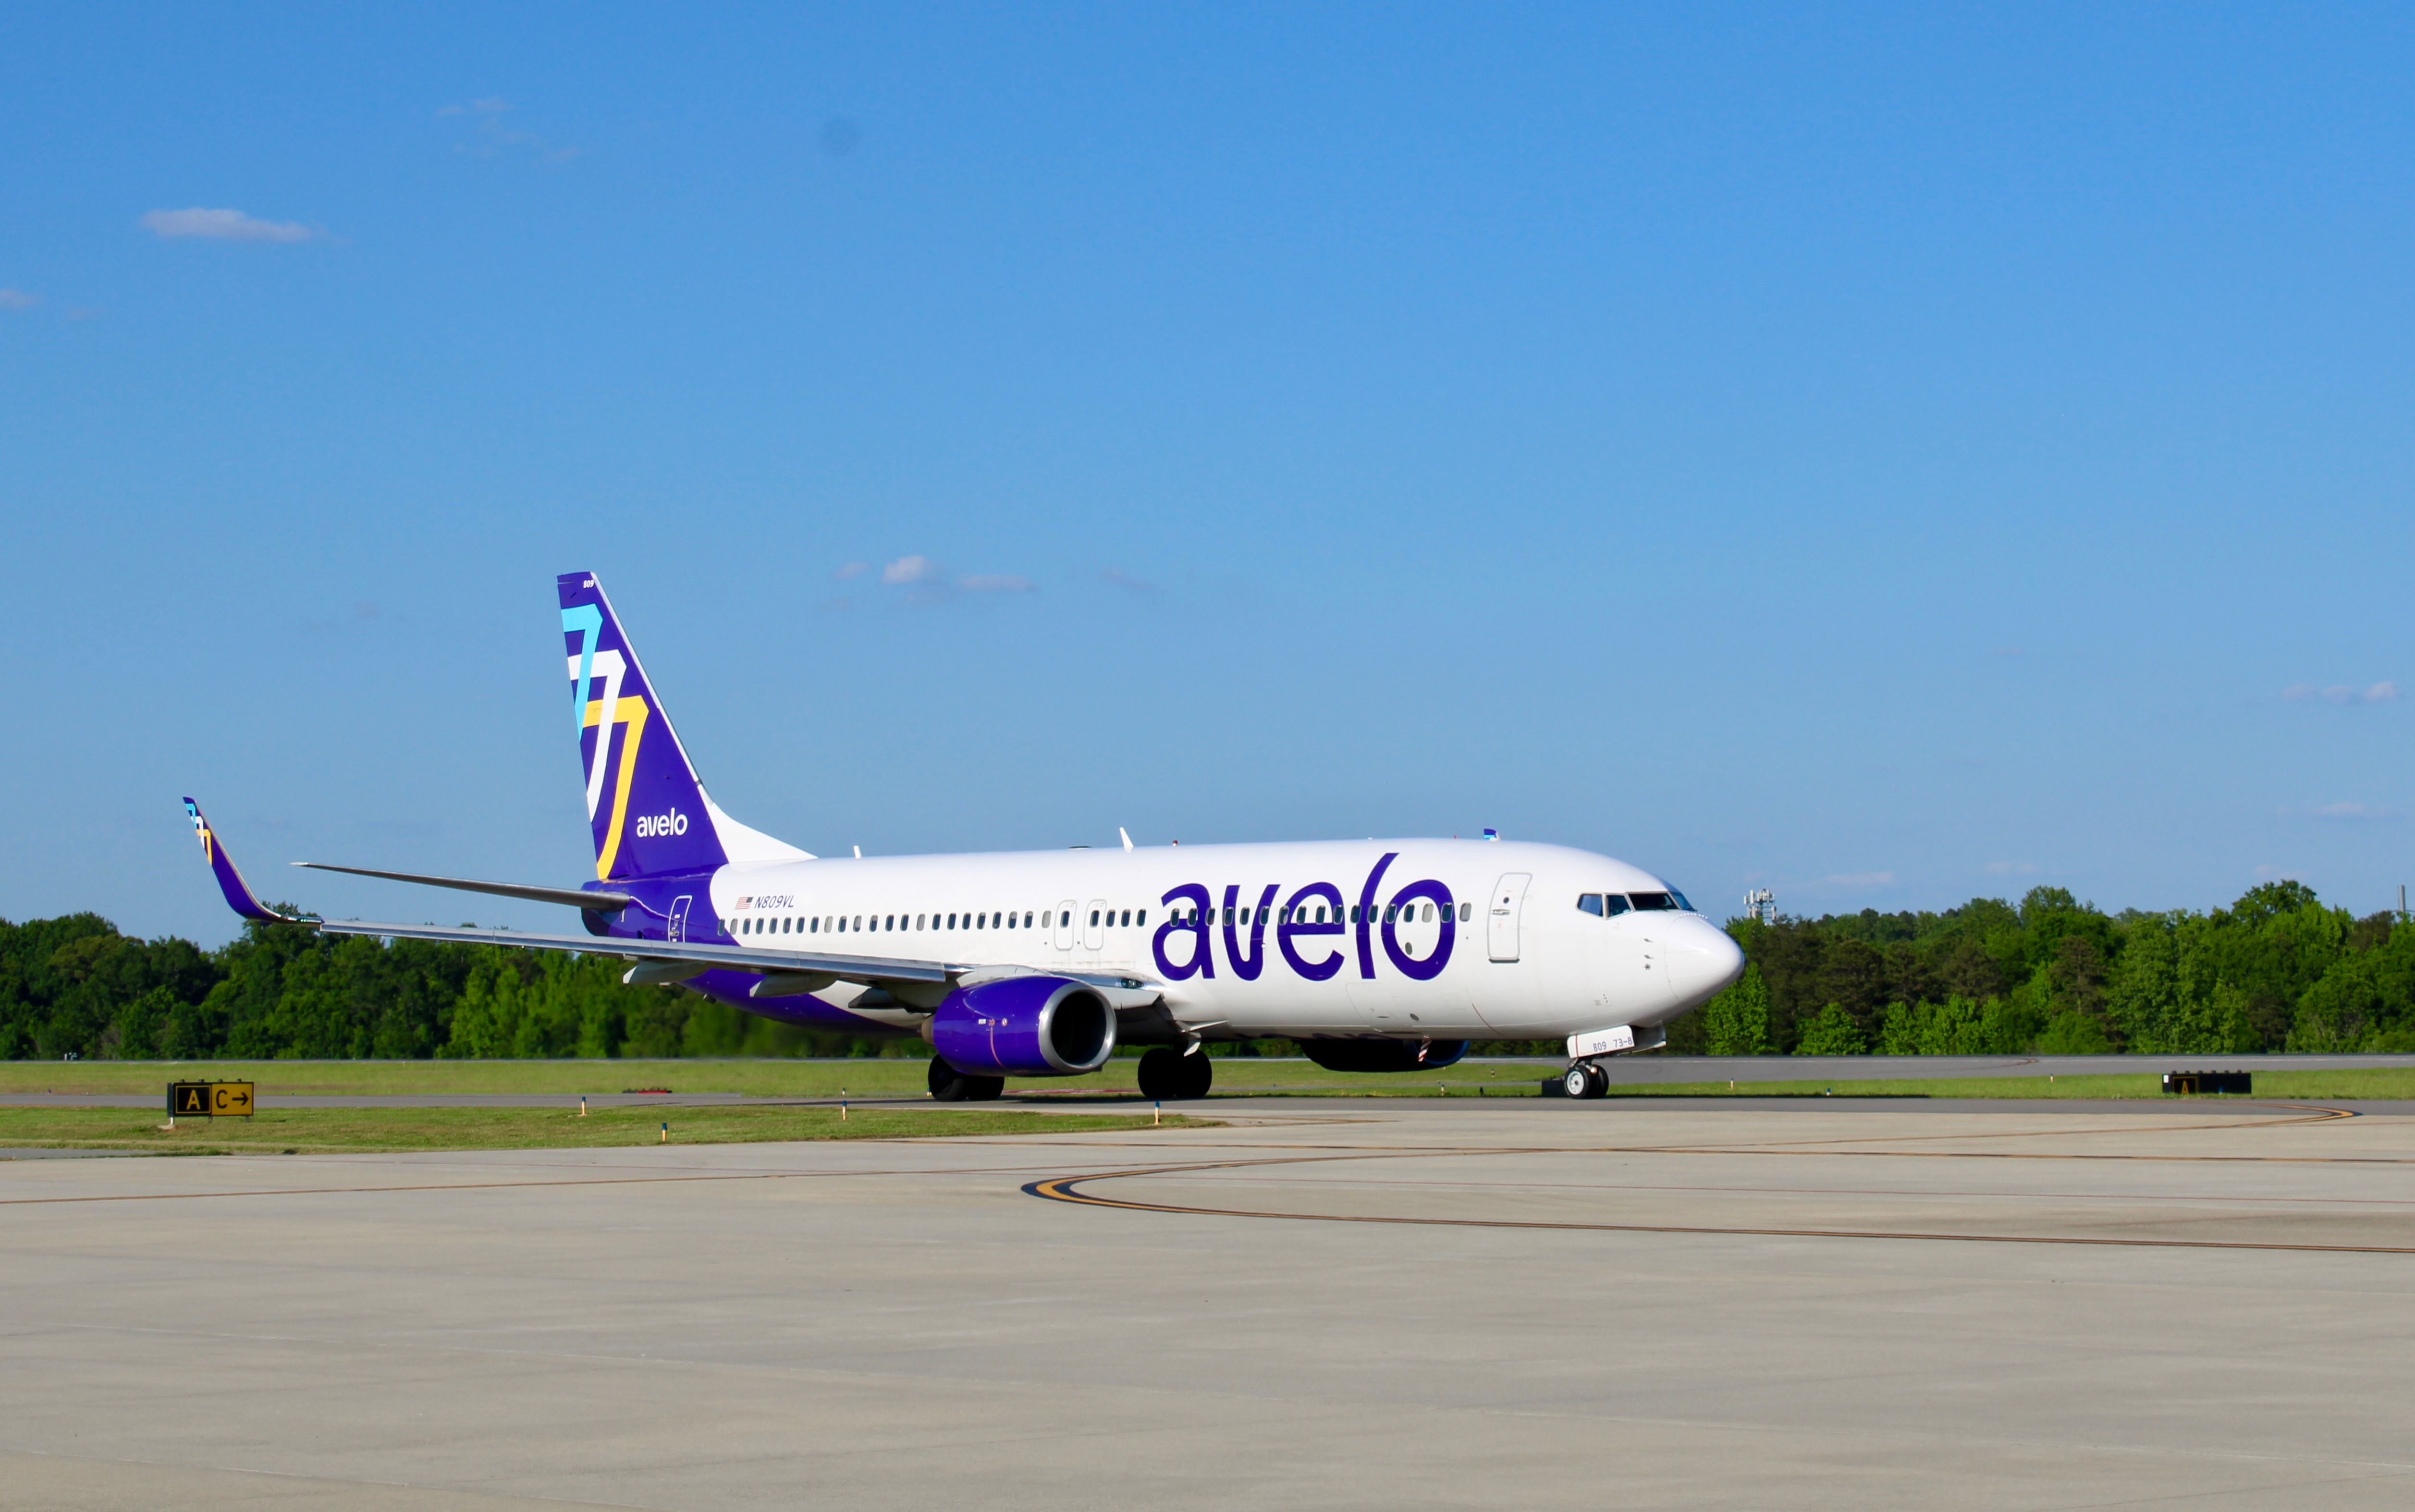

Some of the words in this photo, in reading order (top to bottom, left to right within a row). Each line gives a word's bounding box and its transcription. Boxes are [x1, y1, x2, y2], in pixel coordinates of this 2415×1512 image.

[583, 580, 594, 588] 809
[637, 807, 688, 838] avelo
[754, 895, 794, 909] N809VL
[1152, 853, 1456, 981] avelo
[1593, 1041, 1607, 1052] 809
[1613, 1036, 1632, 1048] 73-8
[2182, 1080, 2189, 1094] A
[186, 1089, 200, 1110] A
[216, 1089, 228, 1109] C
